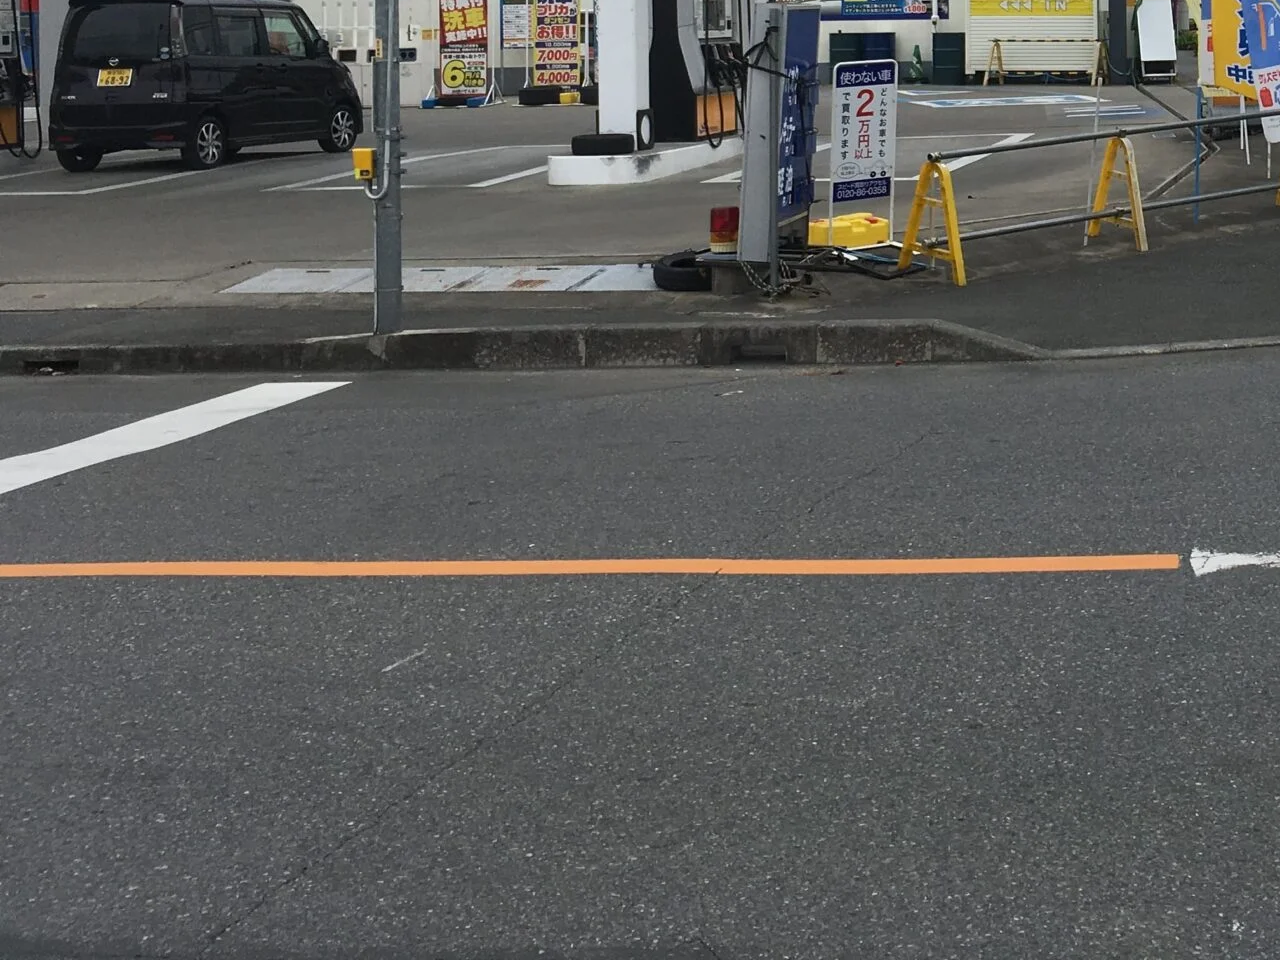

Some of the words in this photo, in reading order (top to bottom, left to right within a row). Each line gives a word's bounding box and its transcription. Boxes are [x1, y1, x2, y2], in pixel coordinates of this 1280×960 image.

[537, 25, 577, 39] お得!!
[538, 50, 577, 62] 7,000円
[443, 60, 466, 88] 6
[537, 72, 577, 84] 4,000円
[840, 70, 891, 85] 使わない車
[840, 92, 851, 160] で買取ります
[878, 88, 887, 158] どんなお車でも
